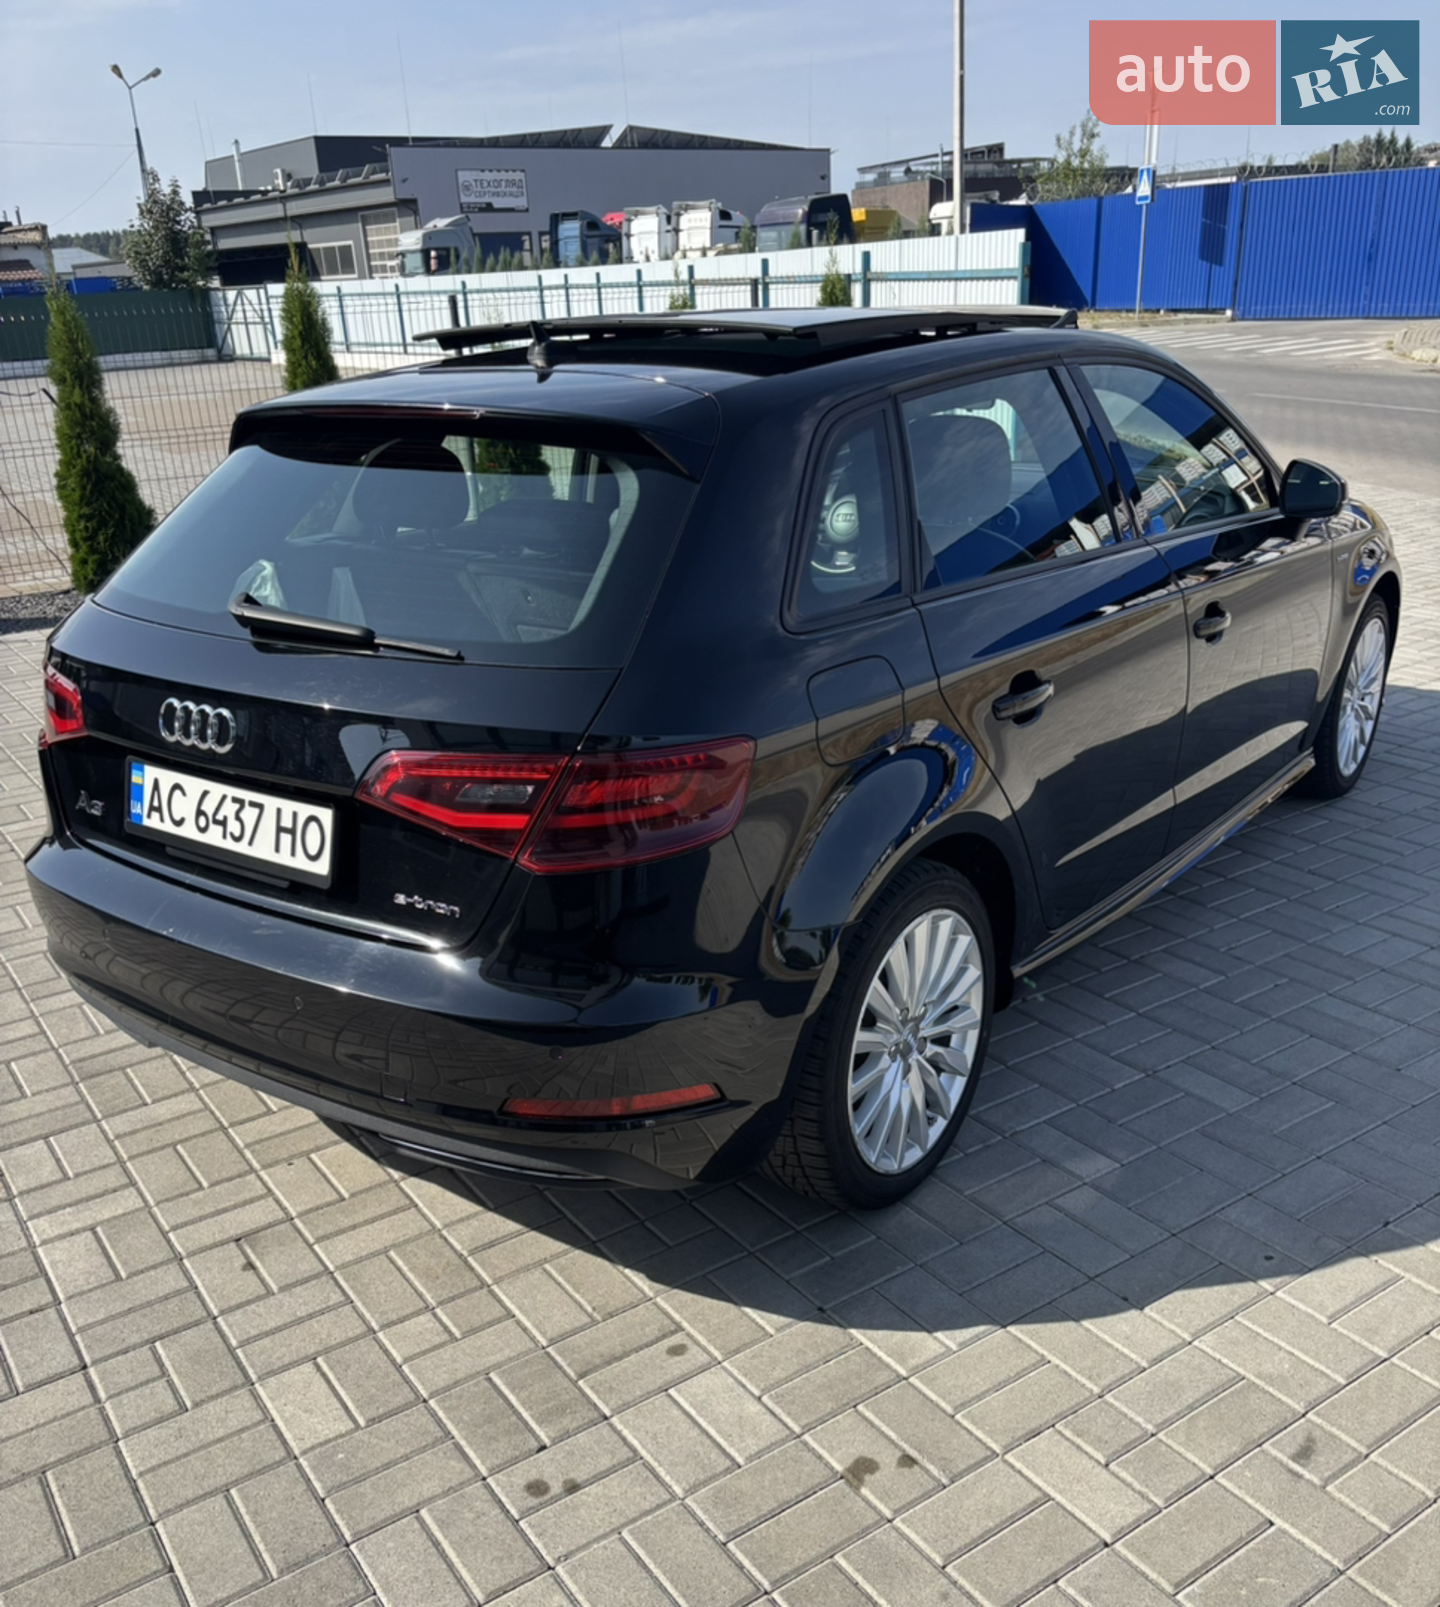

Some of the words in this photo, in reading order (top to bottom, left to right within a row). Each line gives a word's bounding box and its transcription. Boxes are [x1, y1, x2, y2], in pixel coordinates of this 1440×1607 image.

[473, 178, 524, 190] ТЕХОГЛЯД
[75, 789, 105, 816] A3
[130, 800, 143, 816] UA
[146, 777, 187, 828] AC
[194, 789, 265, 847] 6437
[274, 807, 326, 862] HO
[393, 891, 461, 918] e-tron
